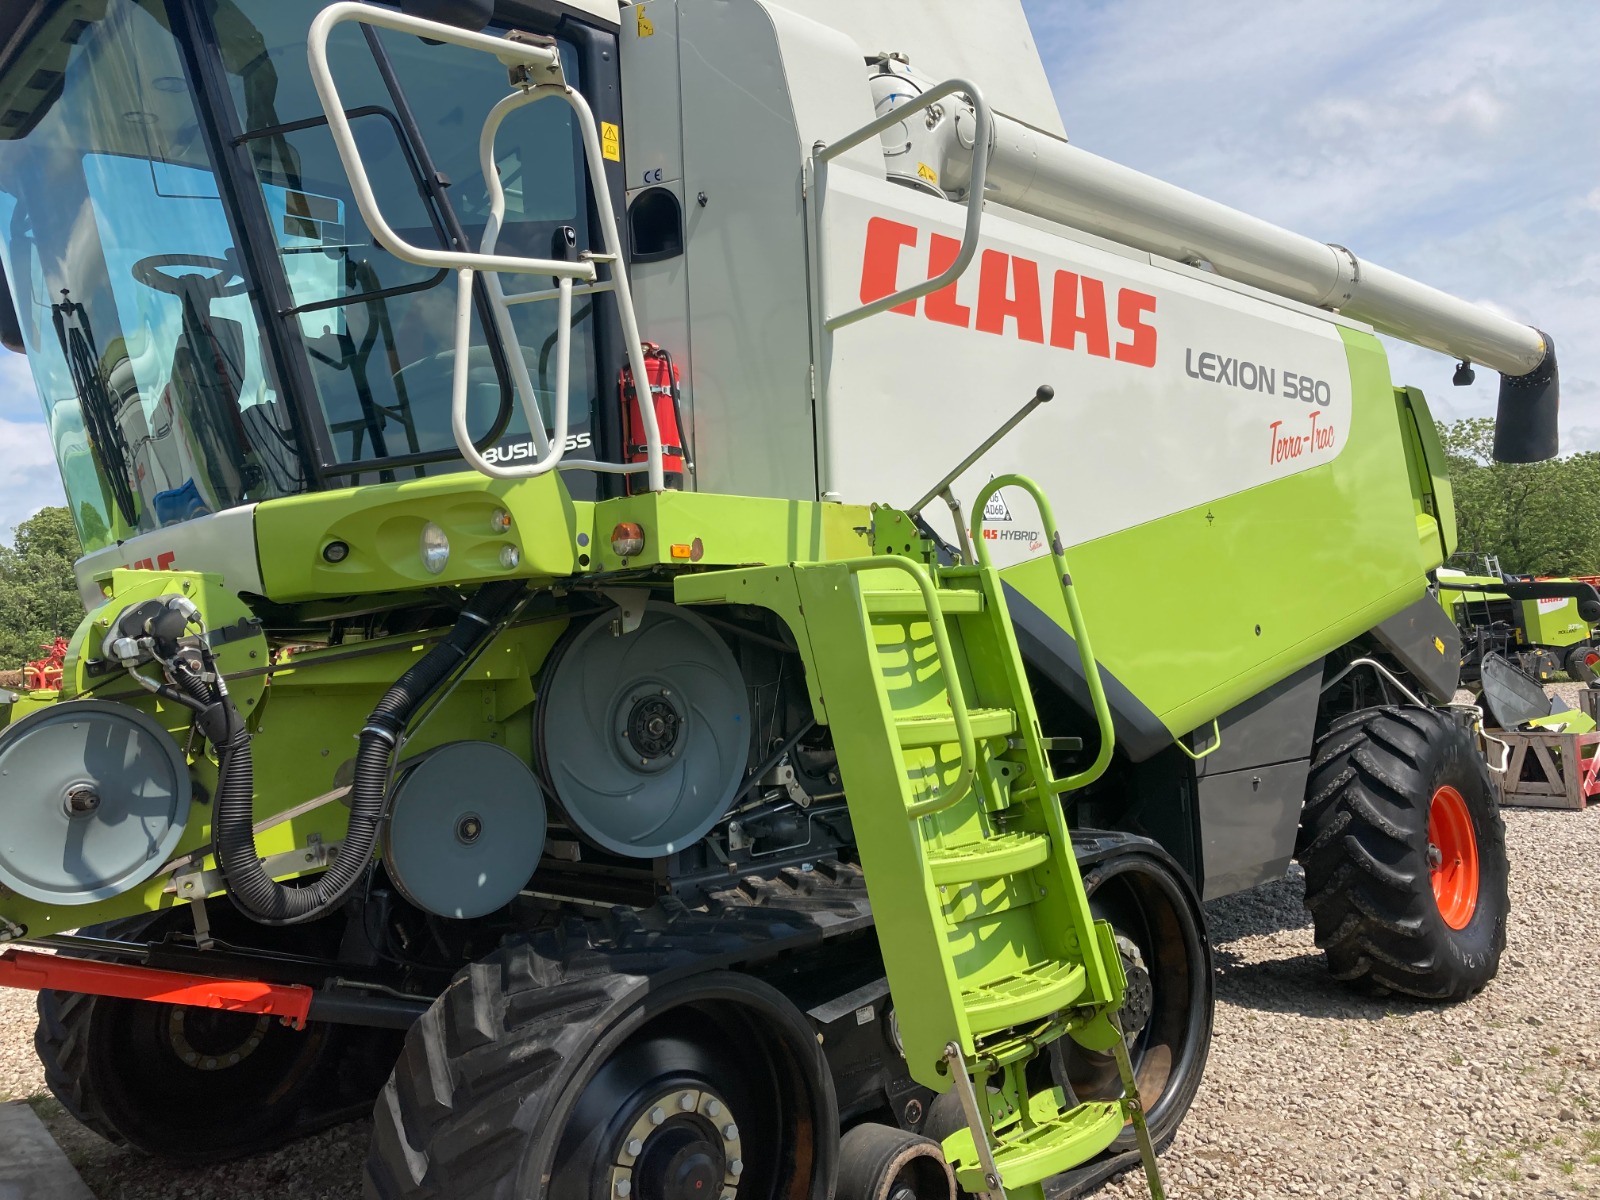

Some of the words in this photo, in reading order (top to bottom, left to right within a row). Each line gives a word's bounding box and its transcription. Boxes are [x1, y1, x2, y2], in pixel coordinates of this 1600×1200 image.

[859, 216, 1157, 368] CLAAS
[1185, 348, 1275, 395] LEXION
[1283, 371, 1331, 407] 580
[1269, 411, 1335, 465] Terra-Trac
[1000, 529, 1038, 541] HYBRID
